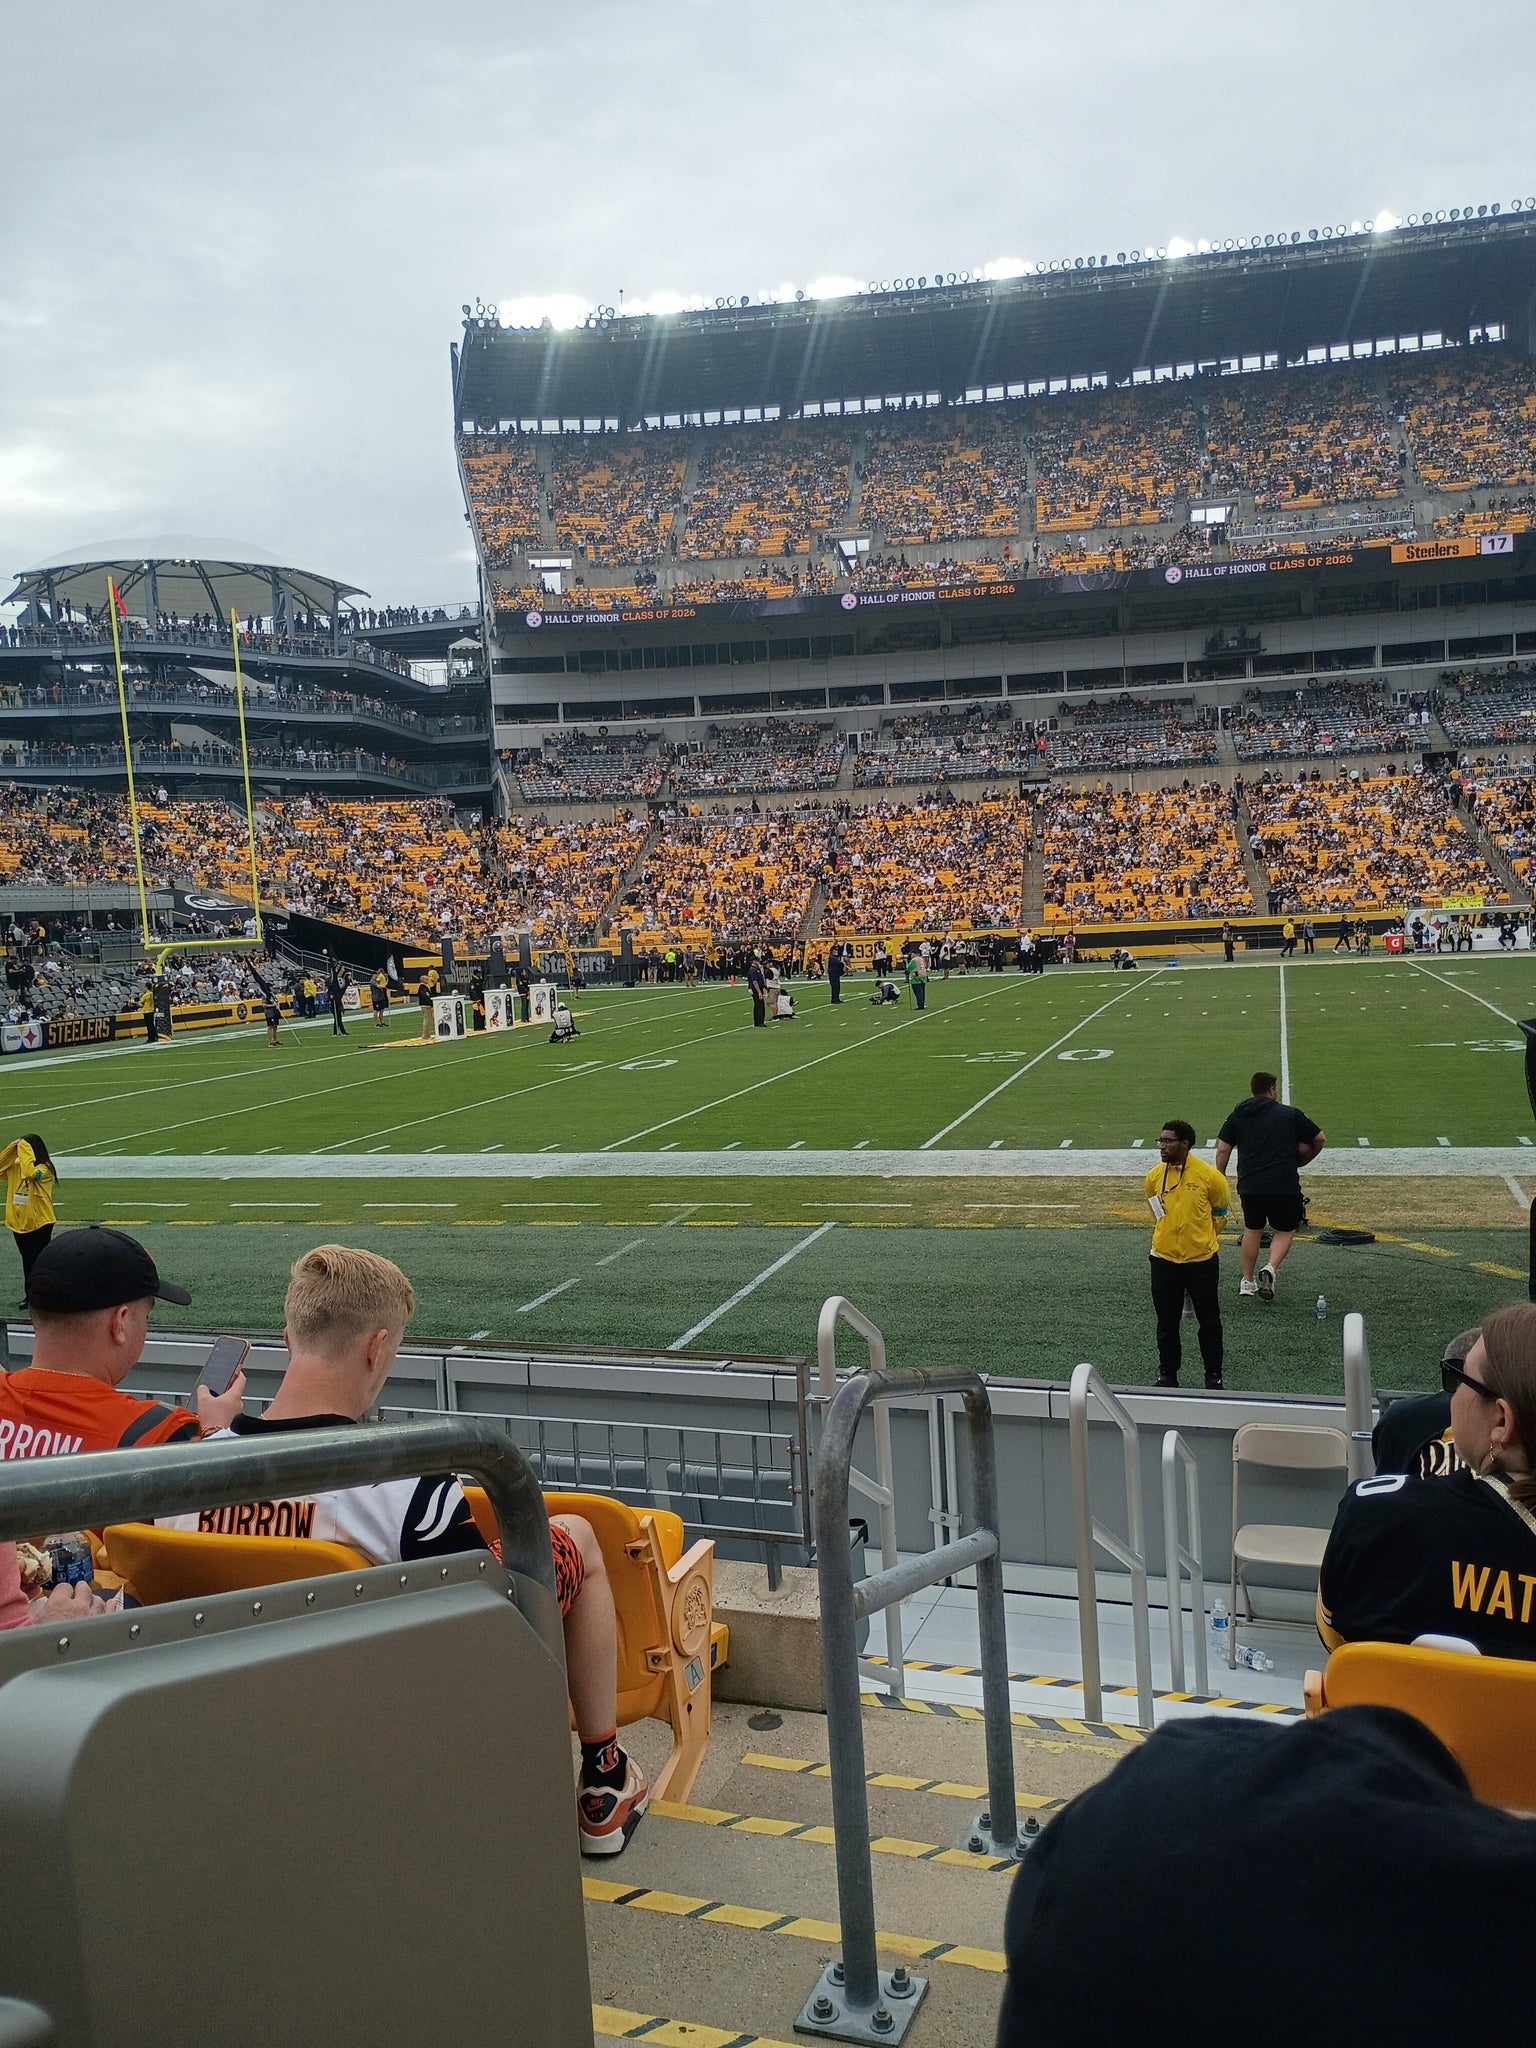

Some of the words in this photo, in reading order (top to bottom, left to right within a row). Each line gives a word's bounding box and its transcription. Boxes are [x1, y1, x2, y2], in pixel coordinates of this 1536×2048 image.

[1406, 543, 1460, 560] Steelers
[1488, 537, 1507, 550] 17
[1185, 567, 1212, 578] HALL
[1213, 566, 1228, 576] OF
[1229, 563, 1266, 574] HONOR
[1269, 558, 1305, 571] CLASS
[1307, 557, 1323, 567] OF
[1325, 555, 1353, 565] 2026
[859, 596, 885, 605] HALL
[886, 594, 899, 603] OF
[901, 592, 935, 602] HONOR
[938, 587, 971, 599] CLASS
[973, 586, 987, 596] OF
[989, 585, 1015, 595] 2026
[545, 615, 570, 624] HALL
[571, 615, 584, 623] OF
[586, 614, 619, 623] HONOR
[621, 611, 654, 621] CLASS
[655, 610, 669, 619] OF
[671, 608, 696, 618] 2026
[1391, 938, 1400, 947] G
[48, 1017, 110, 1045] STEELERS
[198, 1500, 316, 1539] BURROW
[1452, 1560, 1536, 1623] WAT
[690, 1664, 701, 1685] A
